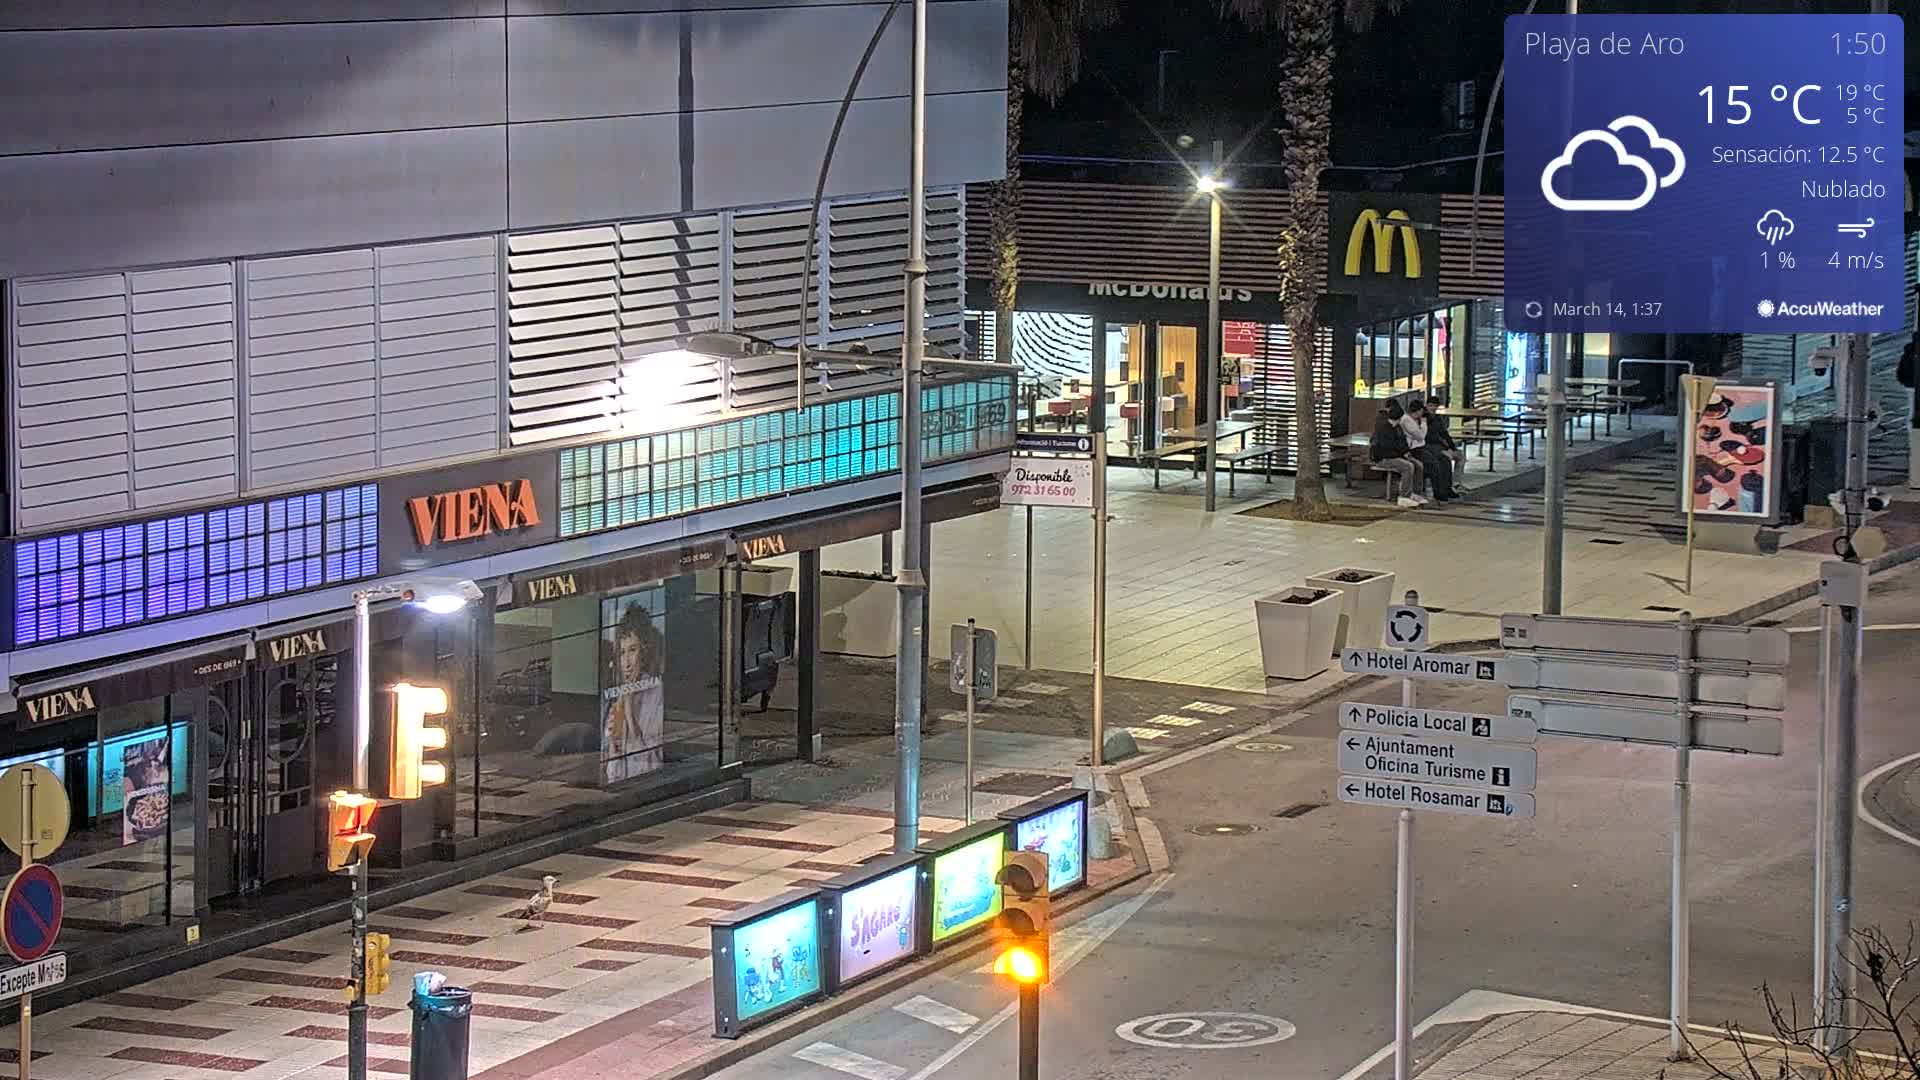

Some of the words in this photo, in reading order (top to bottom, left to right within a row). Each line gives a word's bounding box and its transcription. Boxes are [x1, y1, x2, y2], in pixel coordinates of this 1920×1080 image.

[1015, 467, 1073, 484] Disponible
[1011, 484, 1032, 496] 972
[1063, 486, 1077, 497] 00
[407, 479, 541, 546] VIENA
[743, 533, 787, 560] VIENA
[527, 574, 578, 601] VIENA
[270, 629, 328, 662] VIENA
[1366, 651, 1408, 671] Hotel
[1412, 655, 1471, 675] Aromar
[26, 686, 97, 723] VIENA
[1366, 707, 1419, 728] Policia
[1424, 713, 1467, 732] Local
[1365, 736, 1455, 759] Ajuntament
[1365, 754, 1419, 775] Oficina
[1425, 760, 1487, 781] Turisme
[1365, 781, 1406, 801] Hotel
[1411, 786, 1481, 808] Rosamar
[0, 968, 36, 995] Excepte
